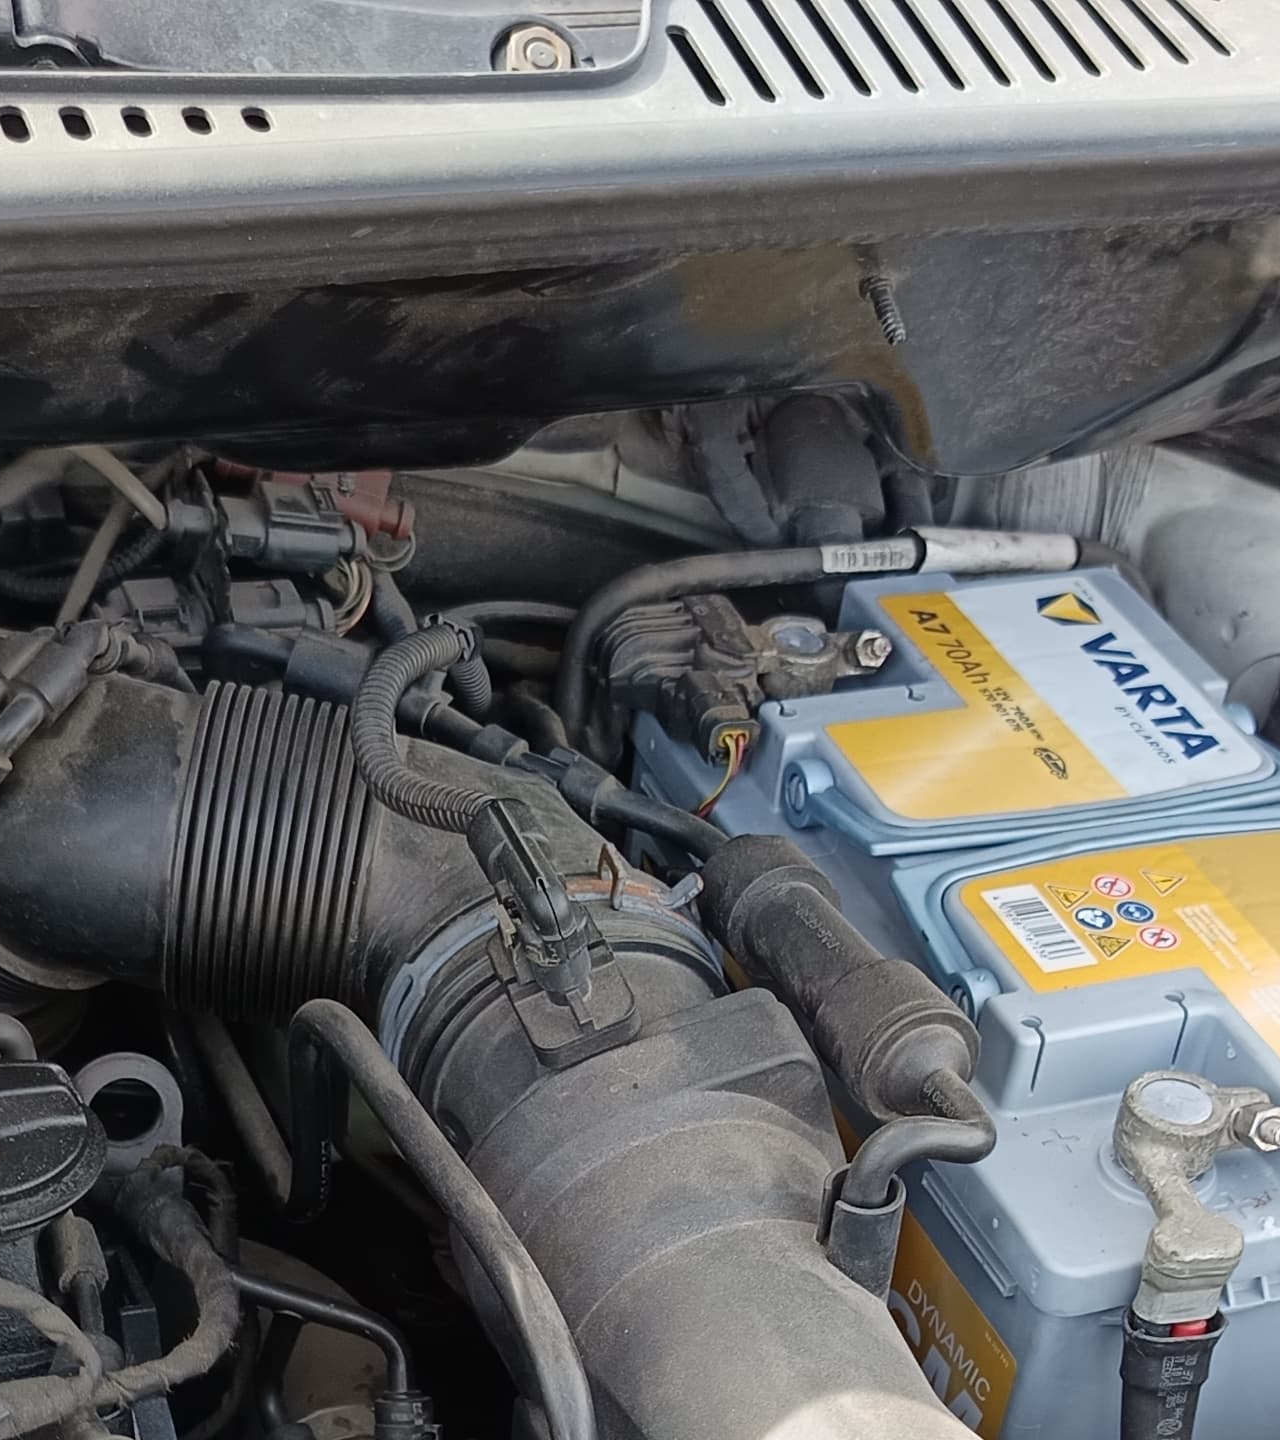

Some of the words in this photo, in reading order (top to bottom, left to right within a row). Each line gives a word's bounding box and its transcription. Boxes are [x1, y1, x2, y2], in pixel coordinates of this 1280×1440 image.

[908, 611, 952, 633] A7
[935, 638, 992, 686] 70Ah
[1079, 631, 1220, 760] VARTA
[1129, 720, 1177, 766] CLARIOS
[907, 1280, 993, 1402] DYNAMIC
